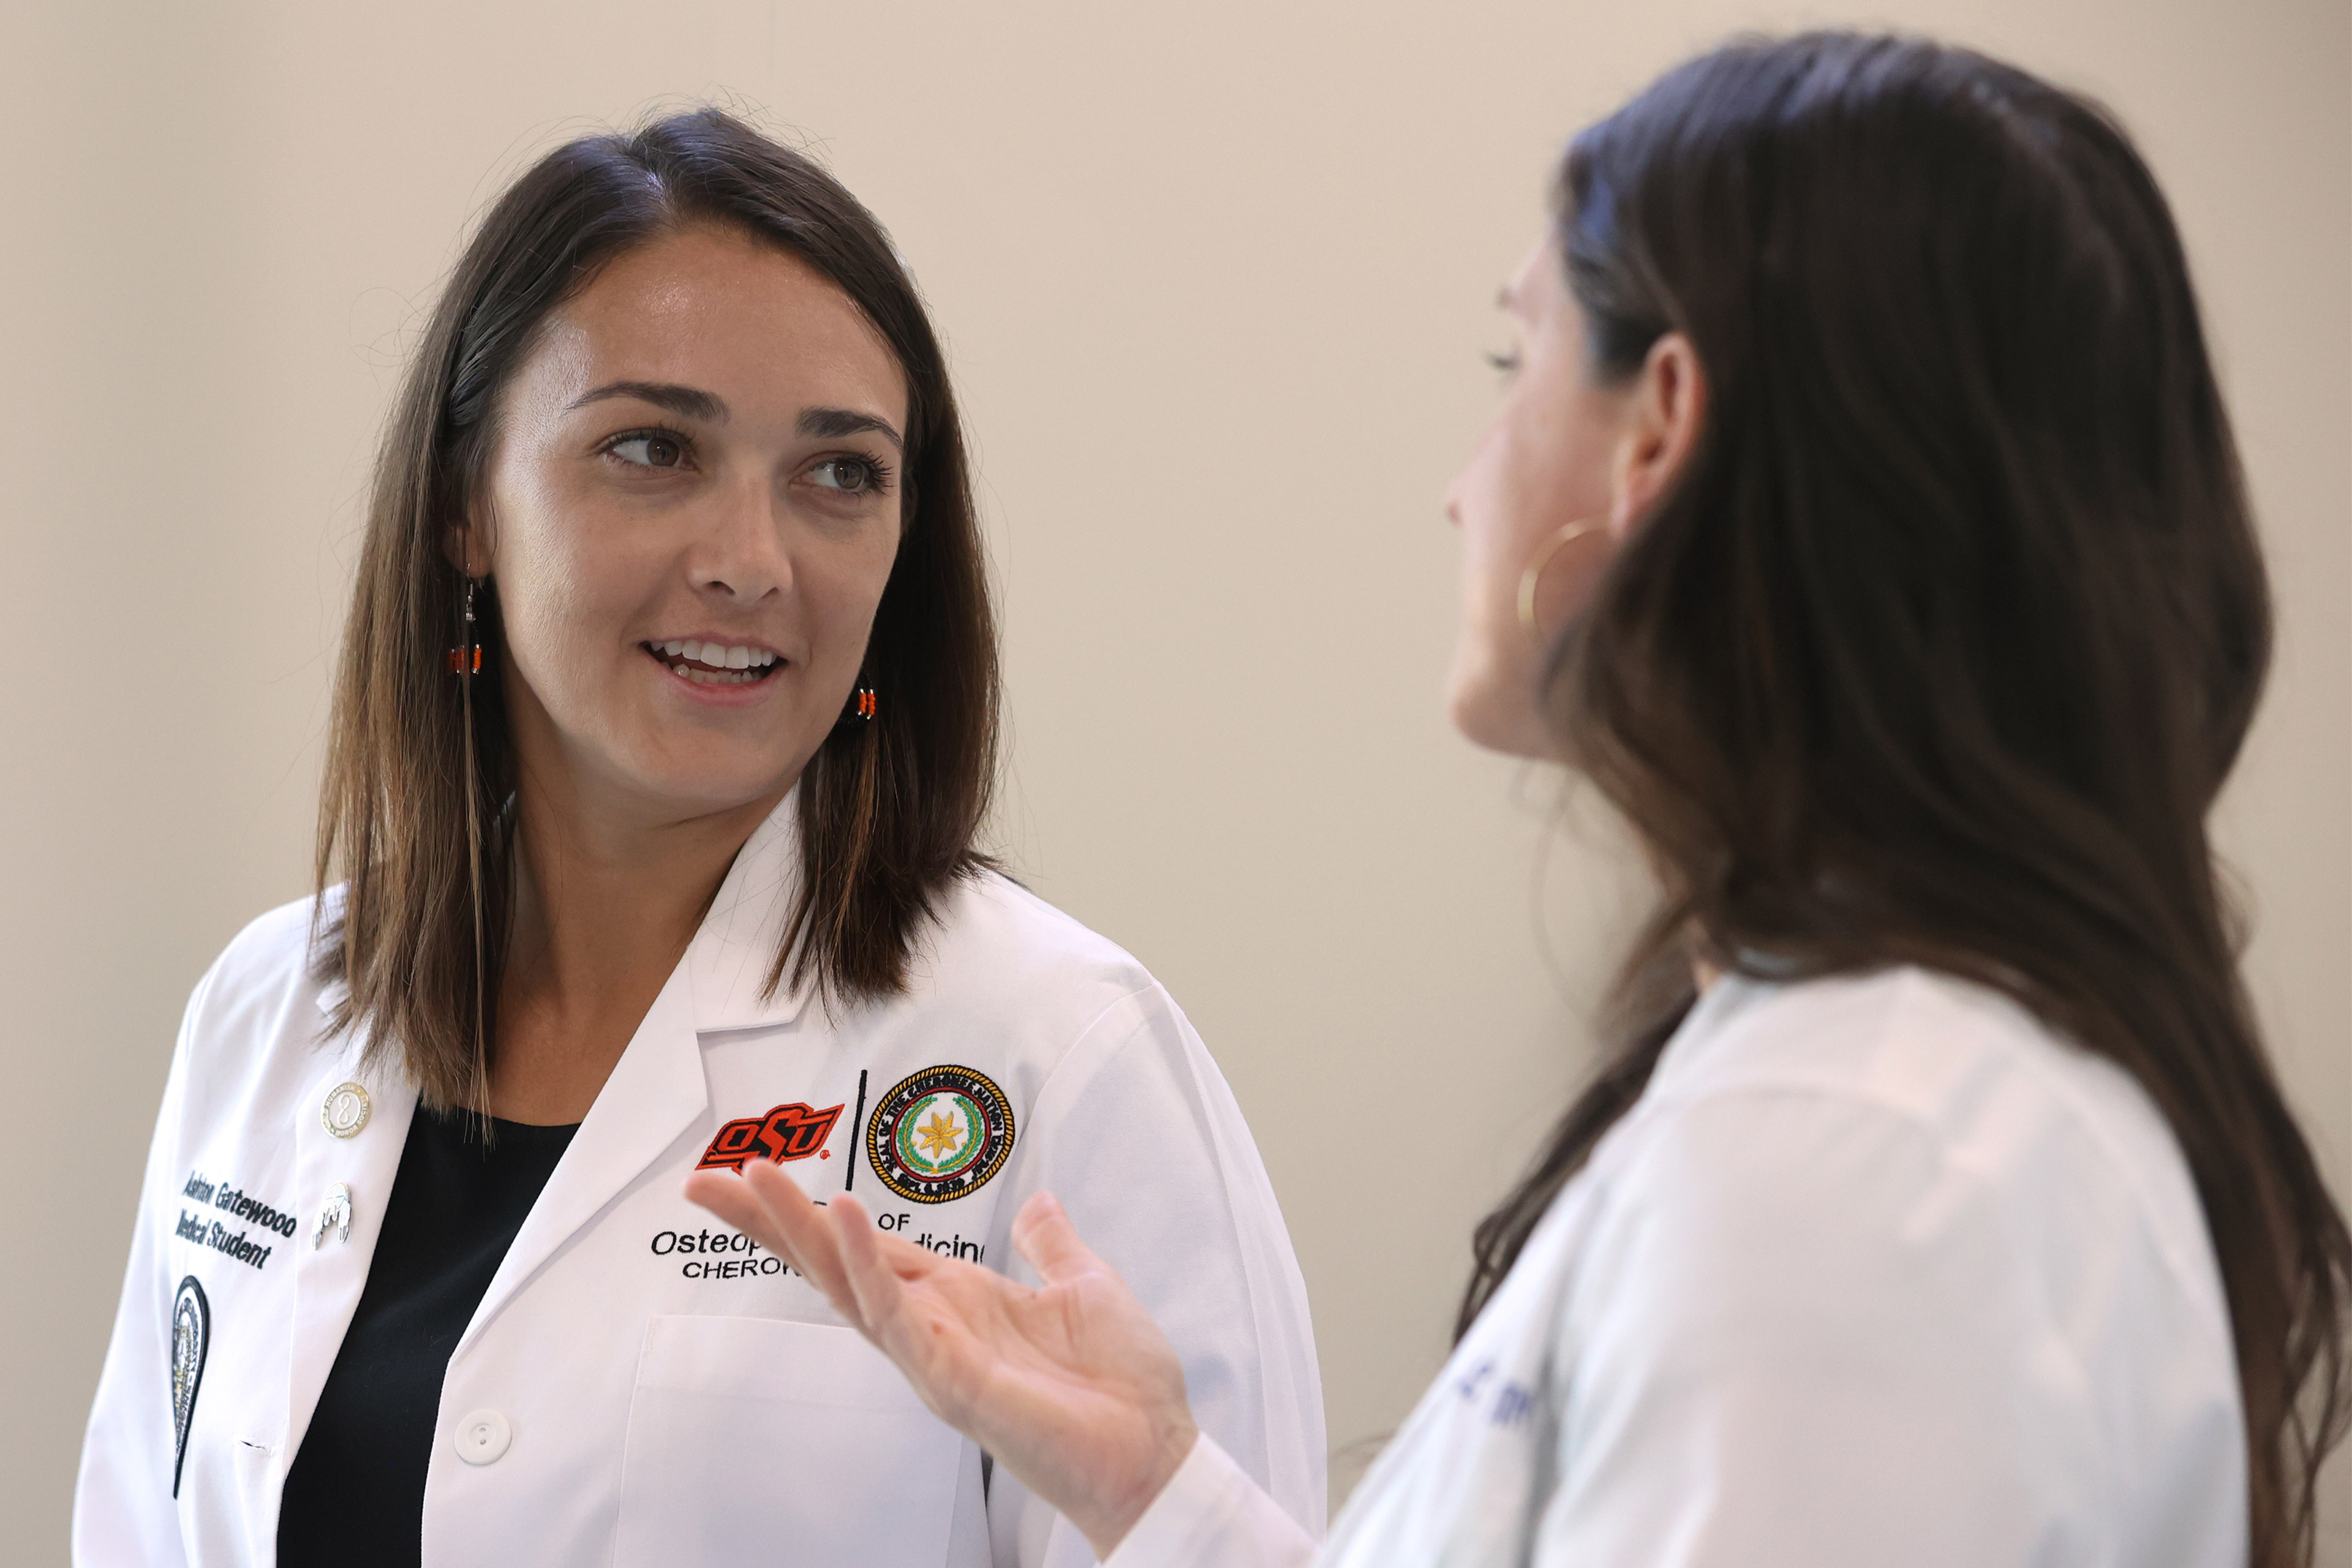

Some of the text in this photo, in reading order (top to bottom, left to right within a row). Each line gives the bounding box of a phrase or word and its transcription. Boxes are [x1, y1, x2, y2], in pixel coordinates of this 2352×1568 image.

[698, 1104, 843, 1176] OSU
[878, 1213, 911, 1232] OF
[207, 1221, 272, 1270] Student
[651, 1228, 763, 1257] Osteop
[682, 1256, 802, 1280] CHERO
